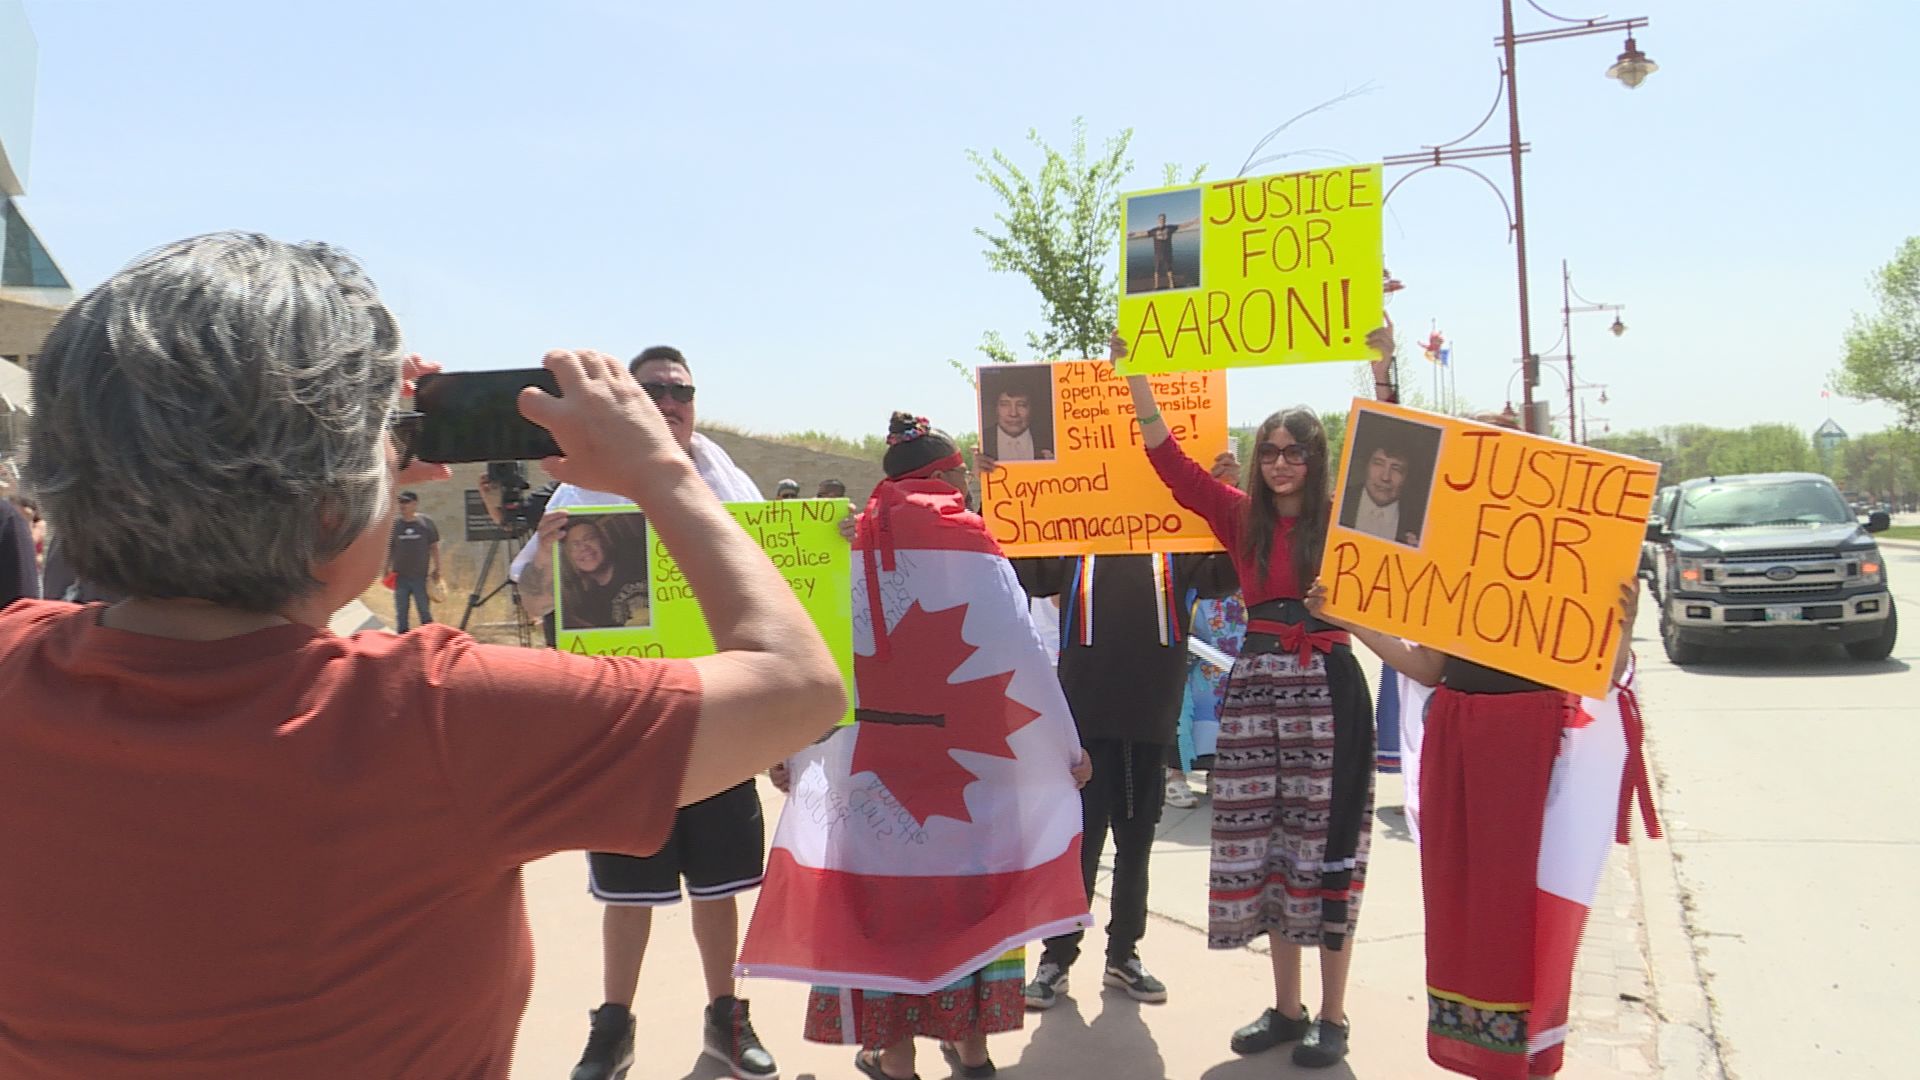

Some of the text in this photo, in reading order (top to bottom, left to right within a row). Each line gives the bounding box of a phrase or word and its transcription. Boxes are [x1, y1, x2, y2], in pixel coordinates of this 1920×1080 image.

[1209, 167, 1374, 226] JUSTICE
[1242, 218, 1335, 278] FOR
[1129, 278, 1351, 363] AARON!
[1059, 361, 1086, 384] 24
[1061, 385, 1106, 404] open,
[1108, 385, 1130, 398] no
[1062, 395, 1213, 424] People rensible
[1067, 423, 1116, 451] Still
[986, 462, 1109, 508] Raymond
[1444, 431, 1658, 523] JUSTICE
[745, 500, 835, 526] with NO
[759, 522, 800, 550] last
[994, 499, 1183, 551] Shannacappo
[1471, 503, 1592, 595] FOR
[1331, 541, 1615, 672] RAYMOND!
